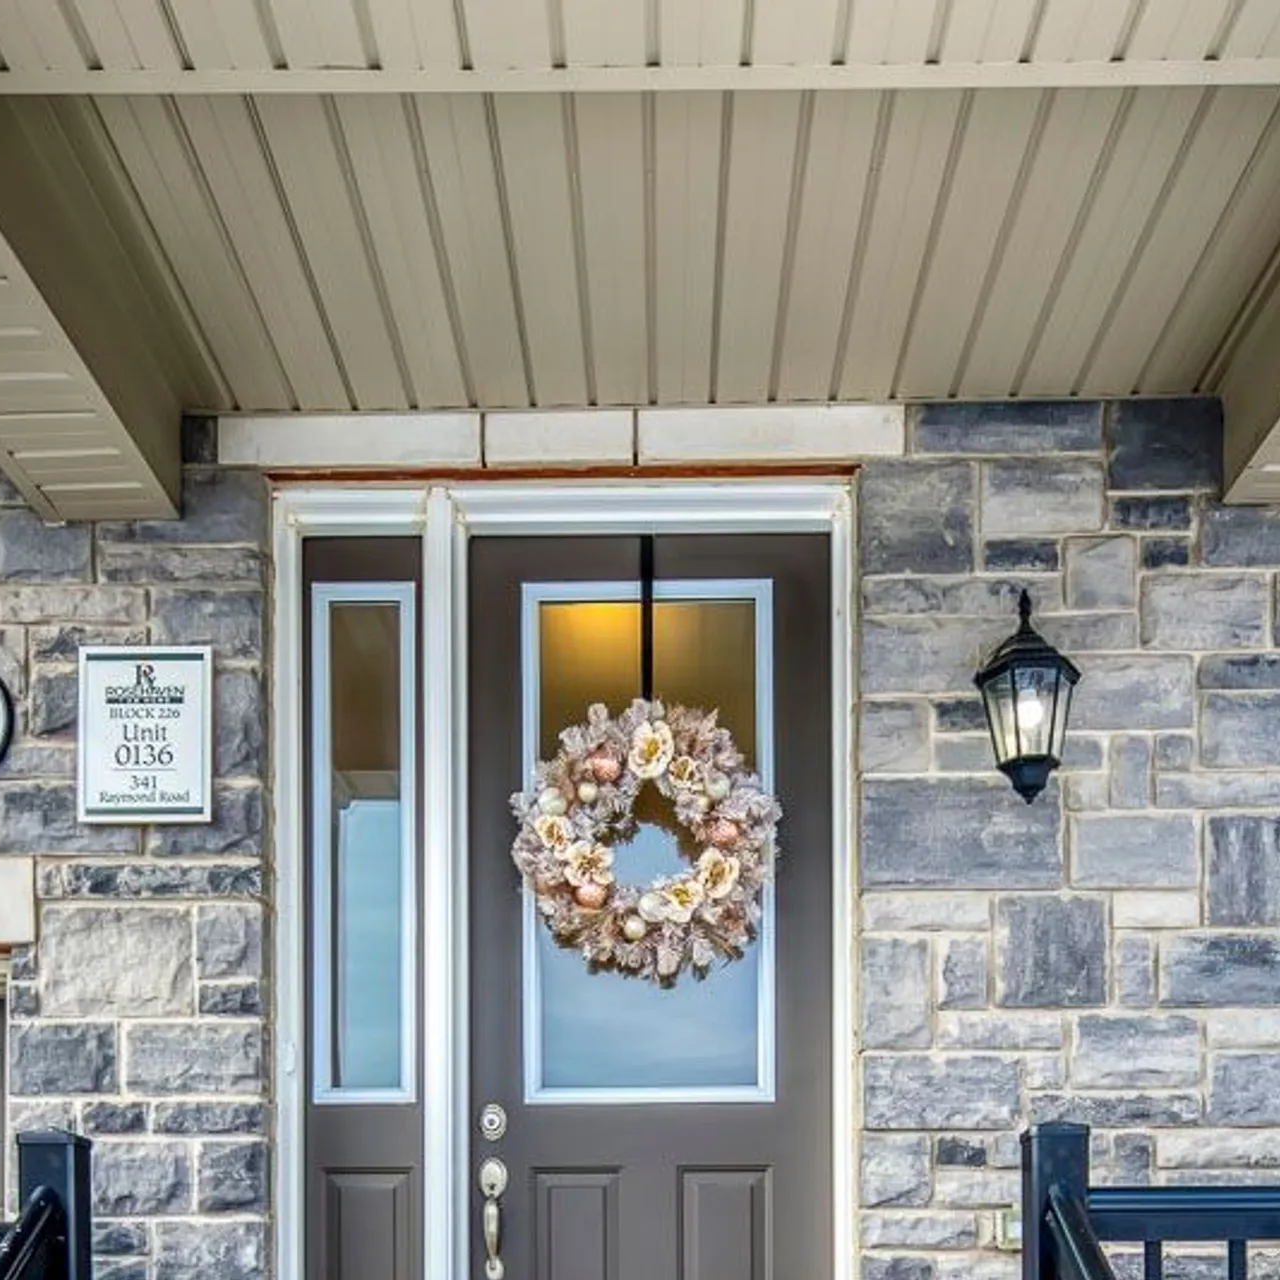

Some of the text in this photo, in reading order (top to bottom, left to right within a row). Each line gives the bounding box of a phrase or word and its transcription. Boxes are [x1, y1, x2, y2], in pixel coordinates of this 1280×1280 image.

[109, 707, 181, 719] BLOCK 226
[123, 723, 167, 742] Unit
[114, 743, 174, 766] 0136
[129, 775, 157, 790] 341
[100, 789, 190, 805] Raymond Road
